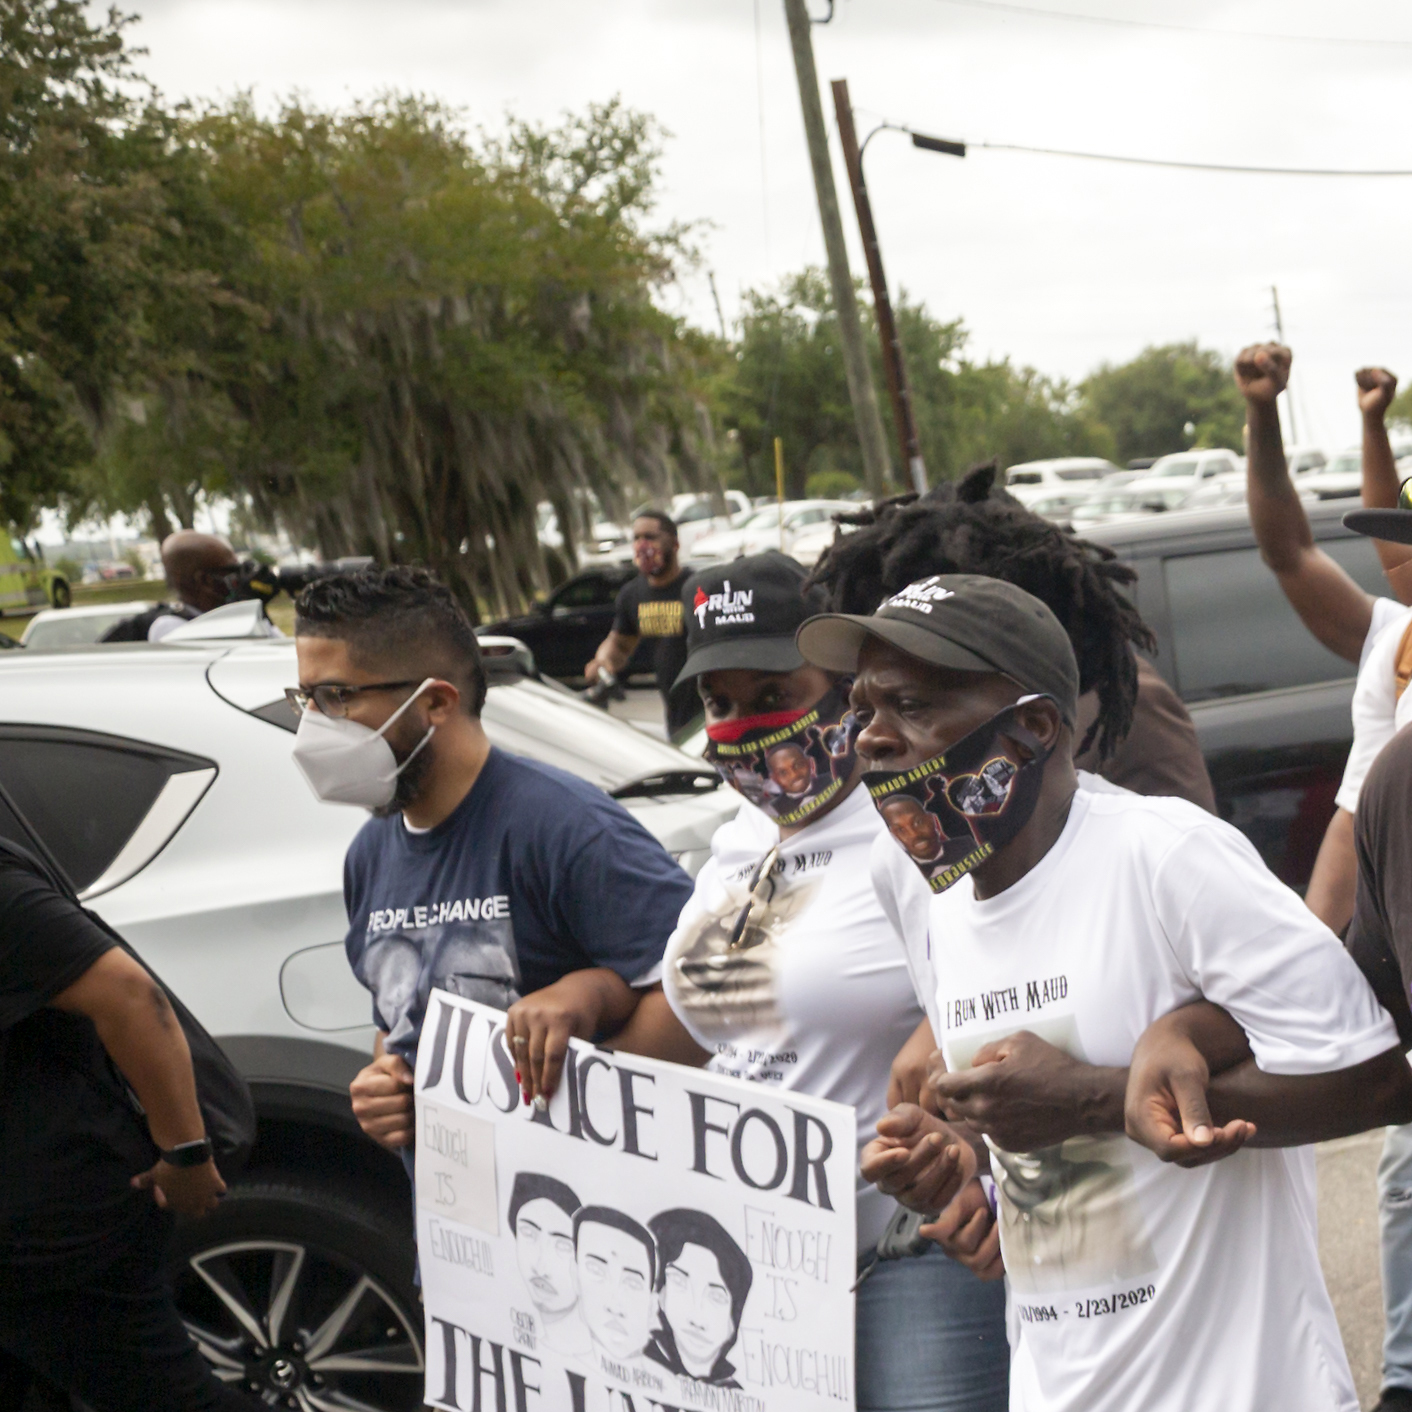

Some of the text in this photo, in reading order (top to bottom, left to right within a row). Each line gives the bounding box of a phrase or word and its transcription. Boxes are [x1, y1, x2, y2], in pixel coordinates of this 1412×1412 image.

[708, 590, 754, 611] RUN
[715, 613, 756, 626] MAUD
[907, 756, 947, 783] ARBERY
[366, 894, 511, 934] PEOPLE CHANGE
[954, 997, 977, 1028] RUN
[981, 986, 1018, 1021] WITH
[1026, 974, 1069, 1014] MAUD
[422, 1000, 837, 1212] JUSICE FOR
[423, 1106, 469, 1168] ENOUGH
[434, 1172, 457, 1207] IS
[742, 1204, 833, 1284] ENOUGH
[764, 1273, 798, 1323] IS
[1075, 1284, 1156, 1319] 2/23/2020
